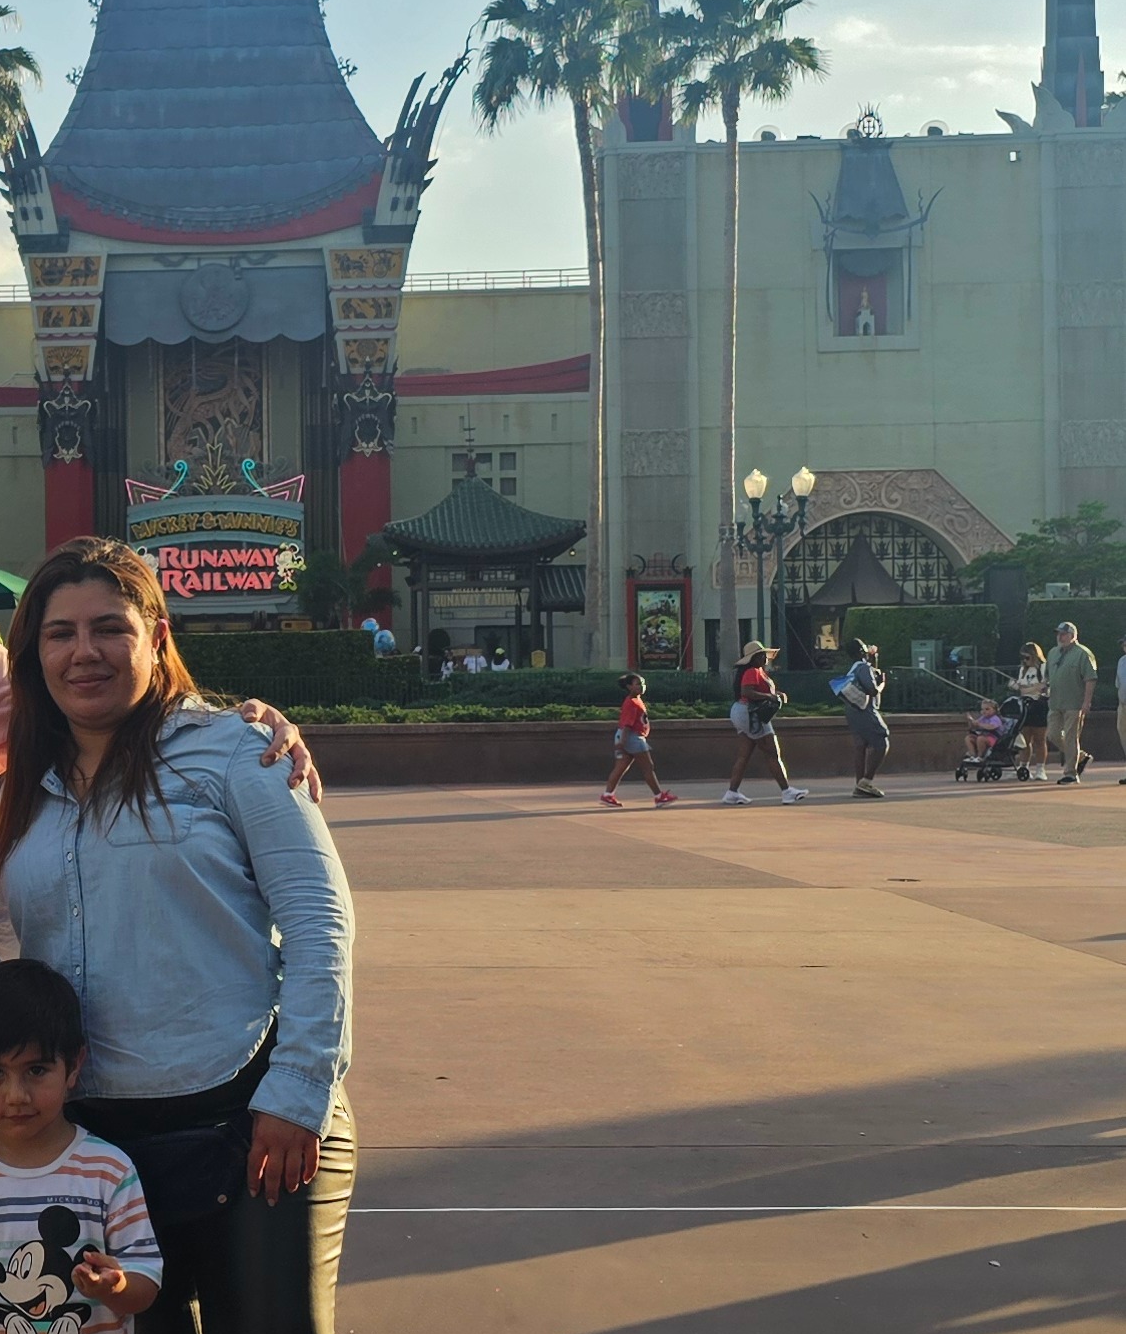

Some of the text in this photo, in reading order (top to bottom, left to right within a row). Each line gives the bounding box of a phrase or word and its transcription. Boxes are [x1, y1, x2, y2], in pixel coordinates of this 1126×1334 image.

[131, 511, 299, 540] MICKEY & MINNIE'S
[158, 547, 279, 569] RUNAWAY
[161, 570, 276, 598] RAILWAY
[433, 593, 481, 607] RUNAWAY
